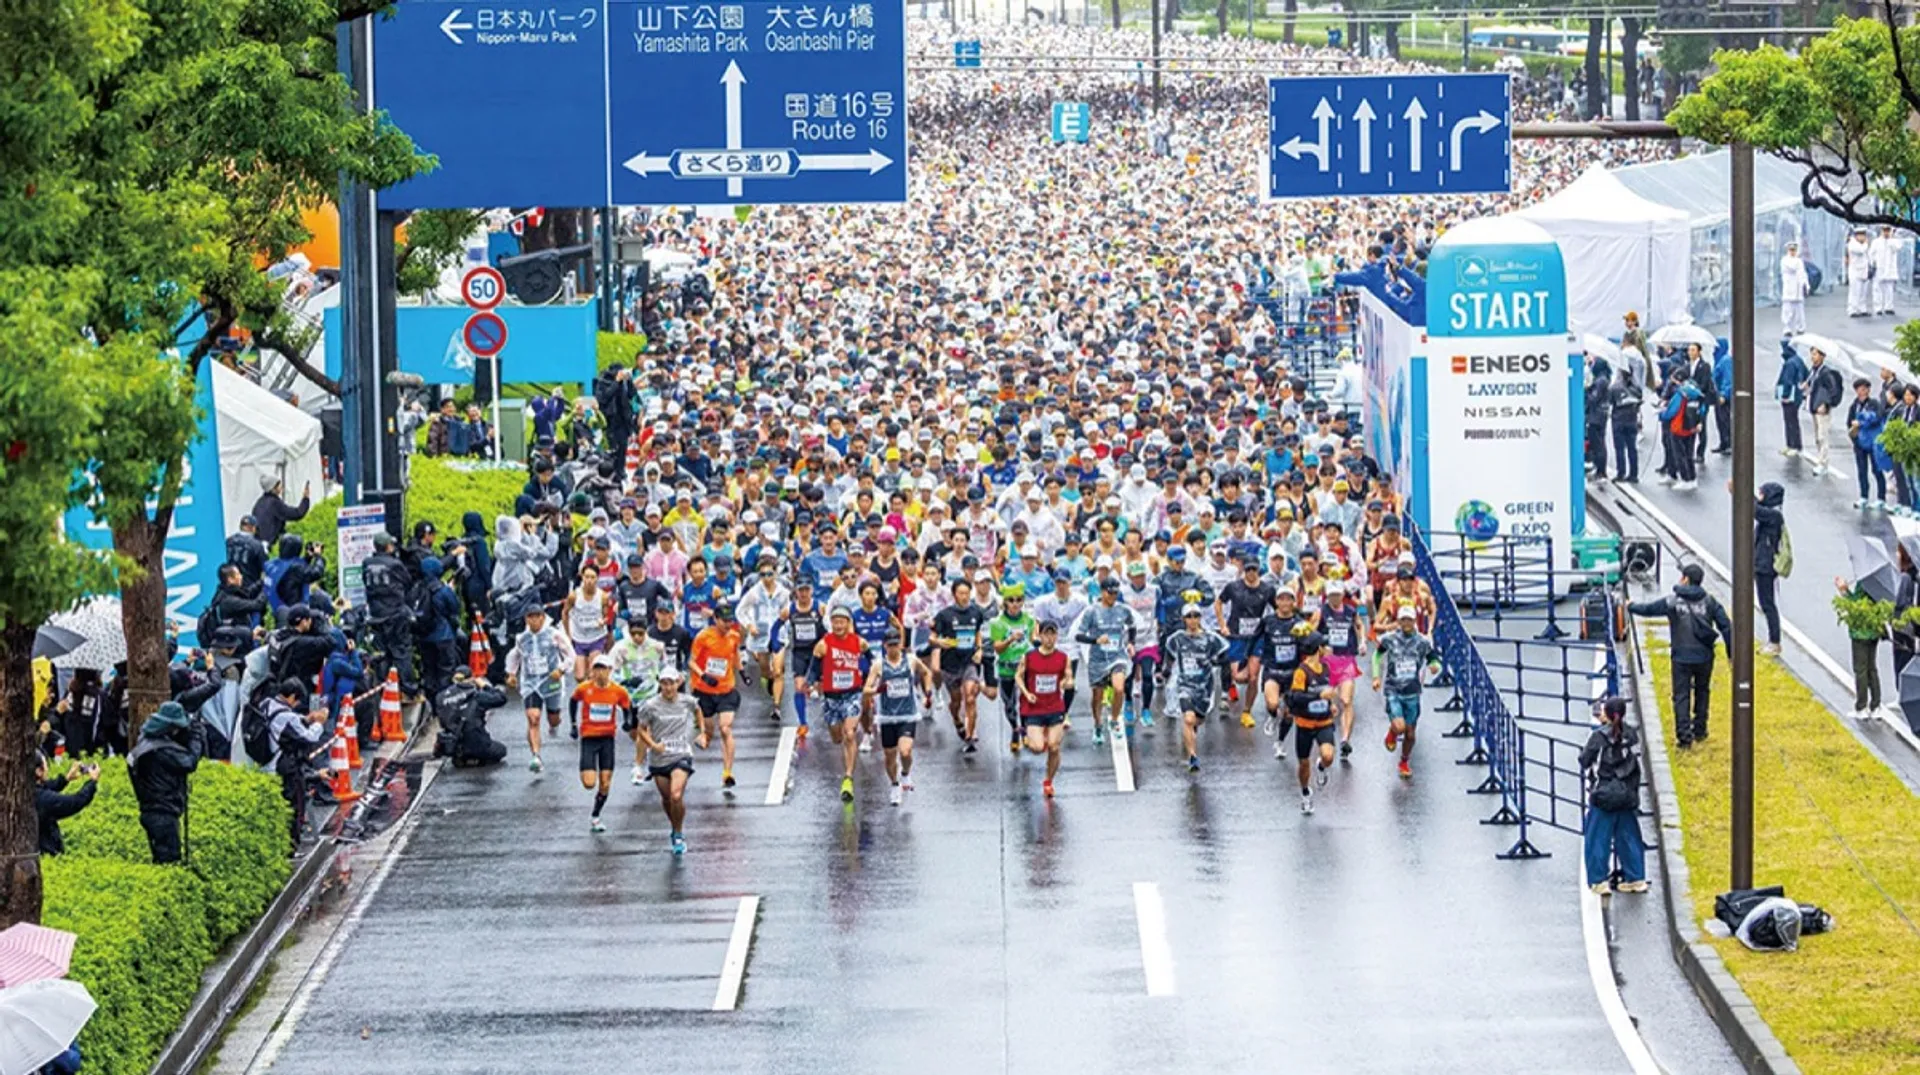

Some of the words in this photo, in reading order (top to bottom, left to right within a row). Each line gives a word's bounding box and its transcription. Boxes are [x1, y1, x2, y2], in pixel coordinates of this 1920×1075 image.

[478, 9, 597, 30] 日本丸パーク
[638, 4, 745, 31] 山下公園
[766, 3, 874, 29] 大さん橋
[476, 32, 548, 45] Nippon-Maru
[552, 31, 577, 43] Park
[634, 32, 710, 52] Yamashita
[715, 32, 748, 51] Park
[765, 31, 841, 51] Osanbashi
[847, 31, 875, 50] Pier
[785, 91, 895, 118] 国道16号
[792, 119, 856, 141] Route
[867, 118, 888, 140] 16
[1060, 112, 1081, 135] E
[686, 155, 783, 173] さくら通り
[470, 278, 496, 299] 50
[1449, 290, 1550, 330] START
[1470, 353, 1551, 374] ENEOS
[1467, 382, 1538, 396] LAWSON
[1463, 406, 1542, 418] NISSAN
[1504, 501, 1555, 515] GREEN
[1511, 522, 1551, 535] EXPO
